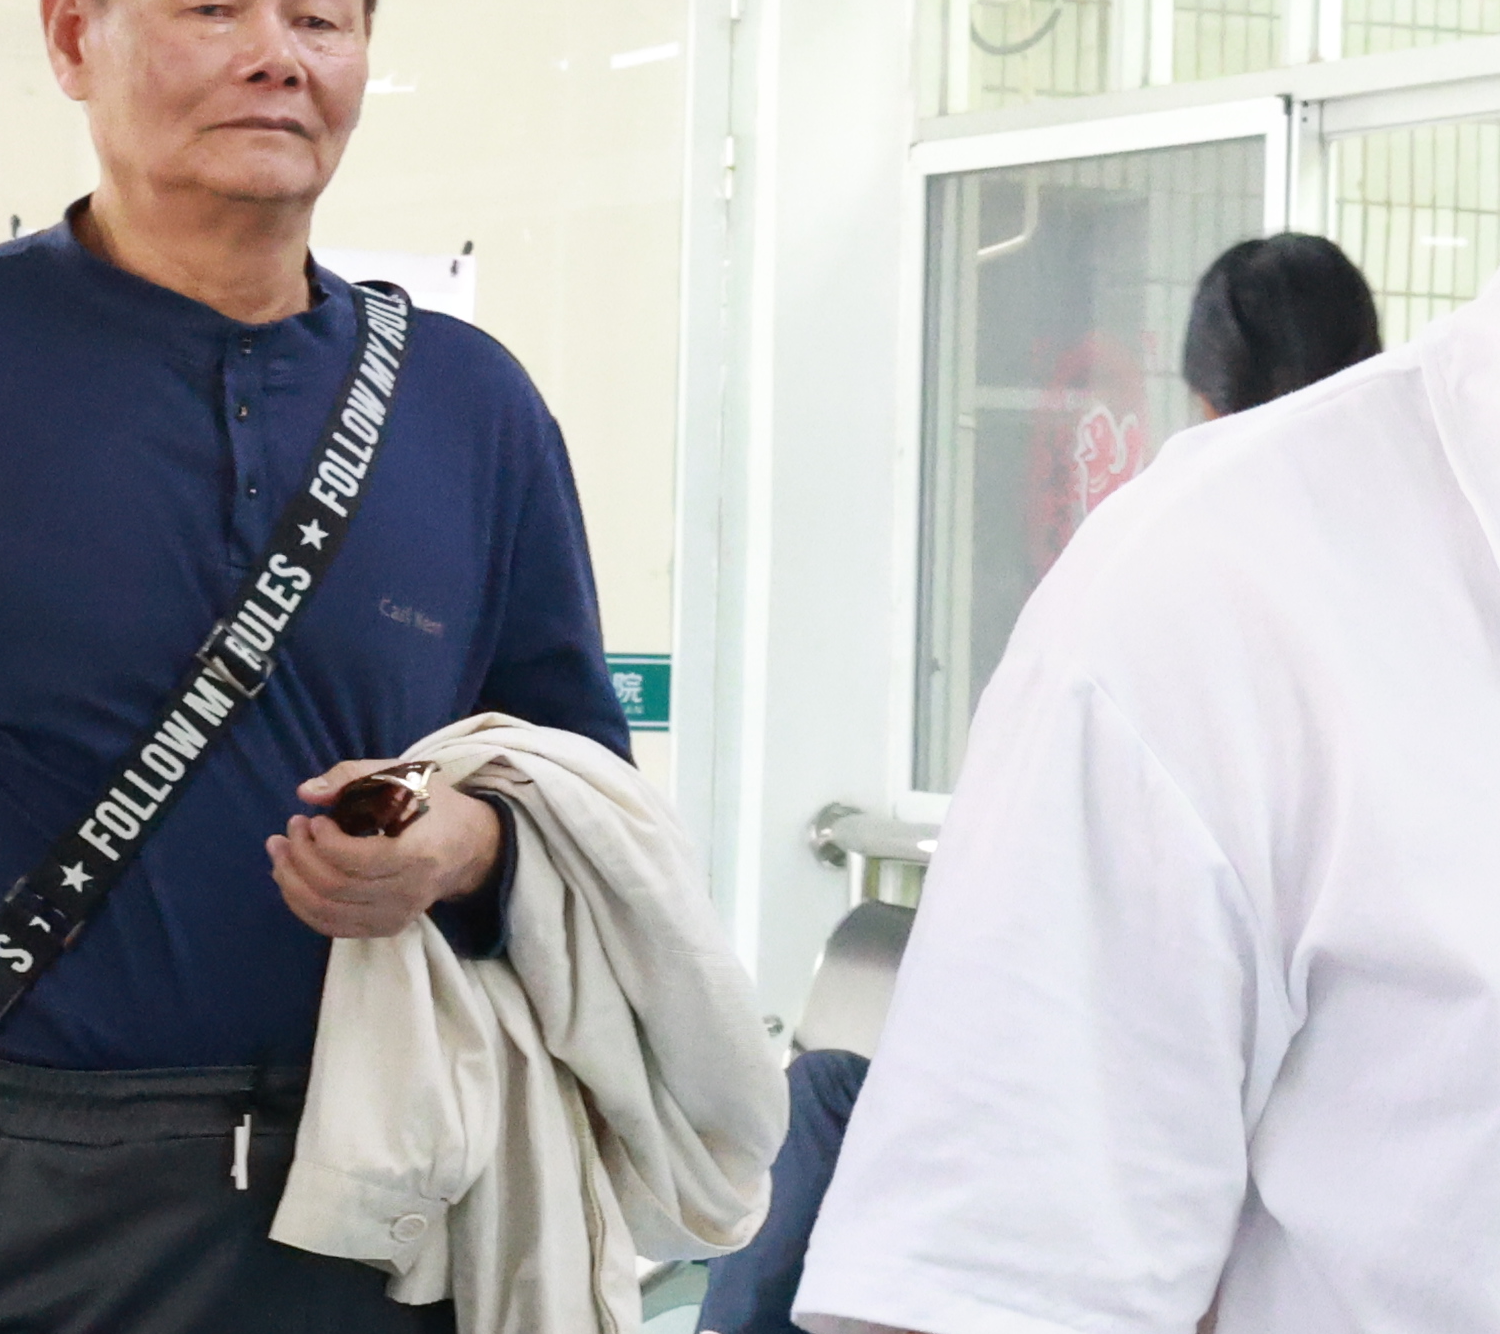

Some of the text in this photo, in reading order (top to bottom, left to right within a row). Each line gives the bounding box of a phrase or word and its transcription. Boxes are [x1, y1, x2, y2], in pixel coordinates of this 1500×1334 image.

[309, 379, 388, 518] FOLLOW
[358, 333, 401, 399] MY
[77, 709, 208, 862] FOLLOW
[223, 553, 312, 672] RULES
[612, 672, 644, 704] 院
